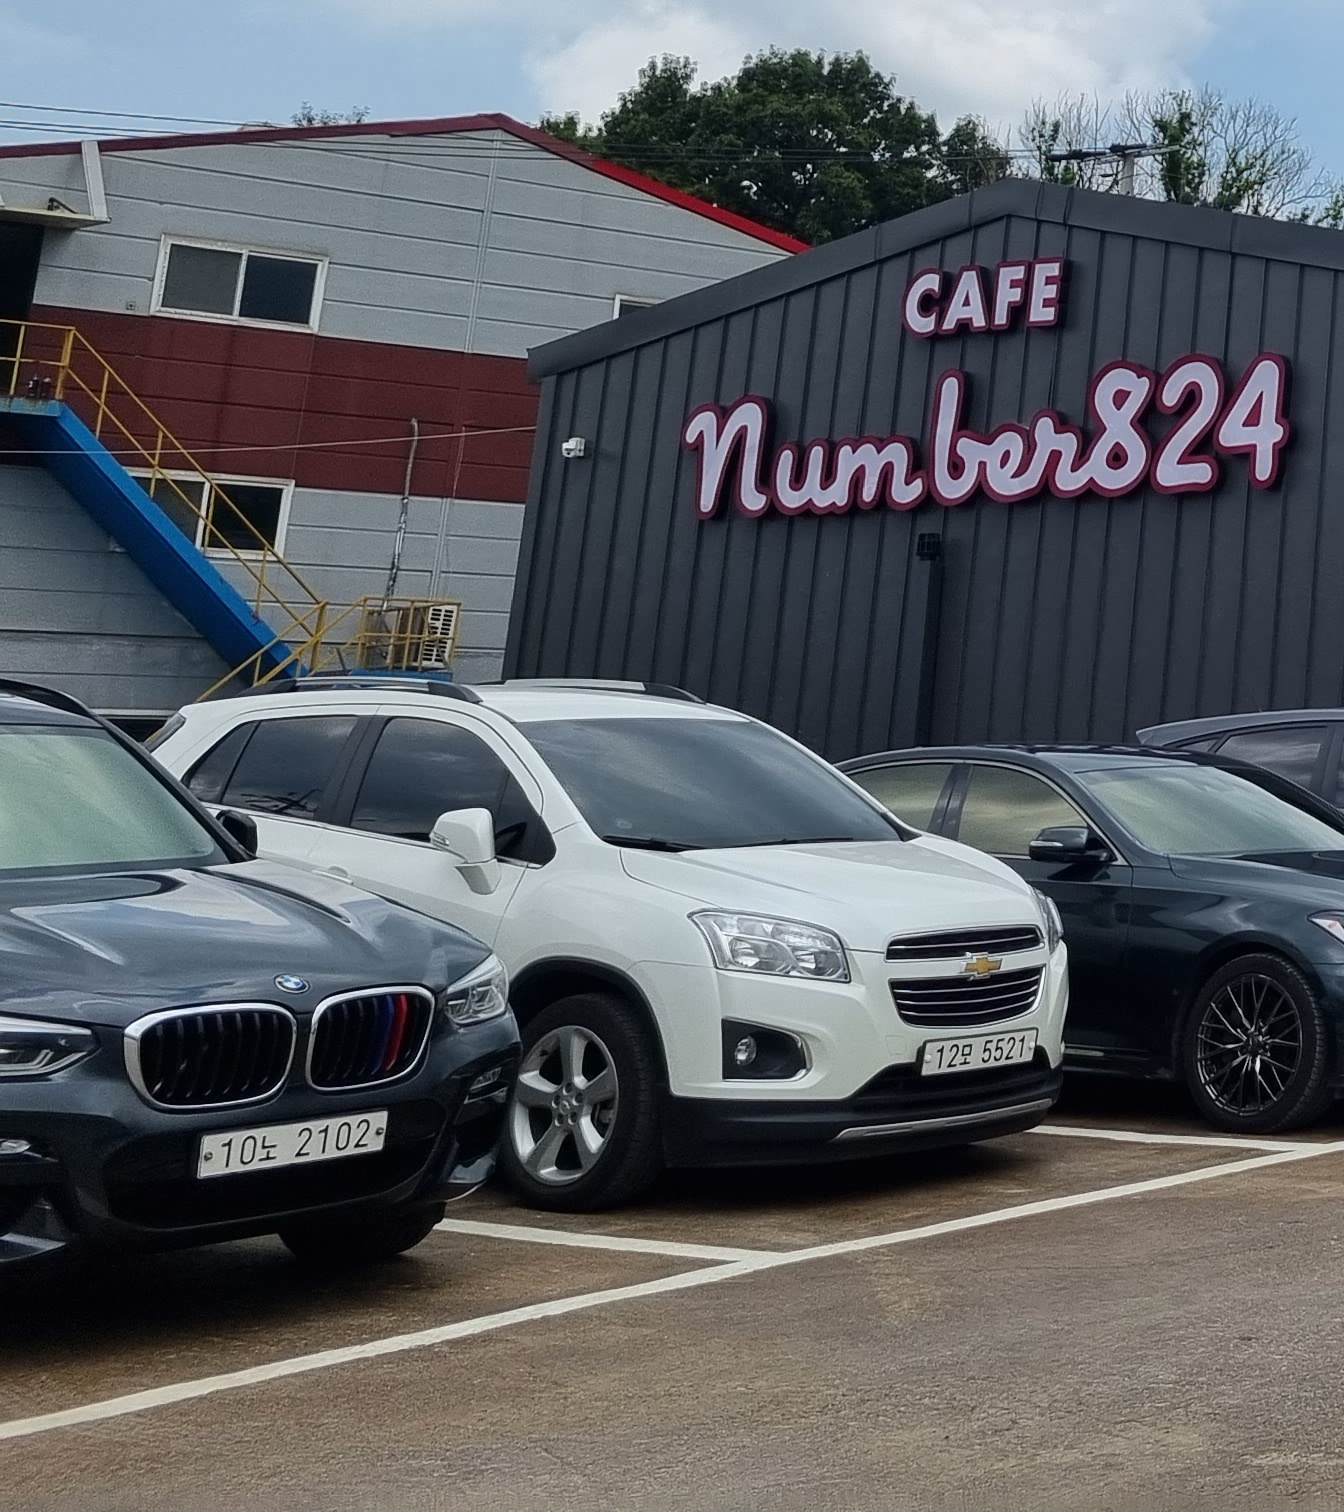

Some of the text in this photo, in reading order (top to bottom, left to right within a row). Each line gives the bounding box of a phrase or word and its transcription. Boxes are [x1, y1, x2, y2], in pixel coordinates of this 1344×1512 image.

[904, 256, 1066, 338] CAFE
[936, 1035, 1026, 1069] 12모 5521
[221, 1118, 371, 1168] 10노 2102
